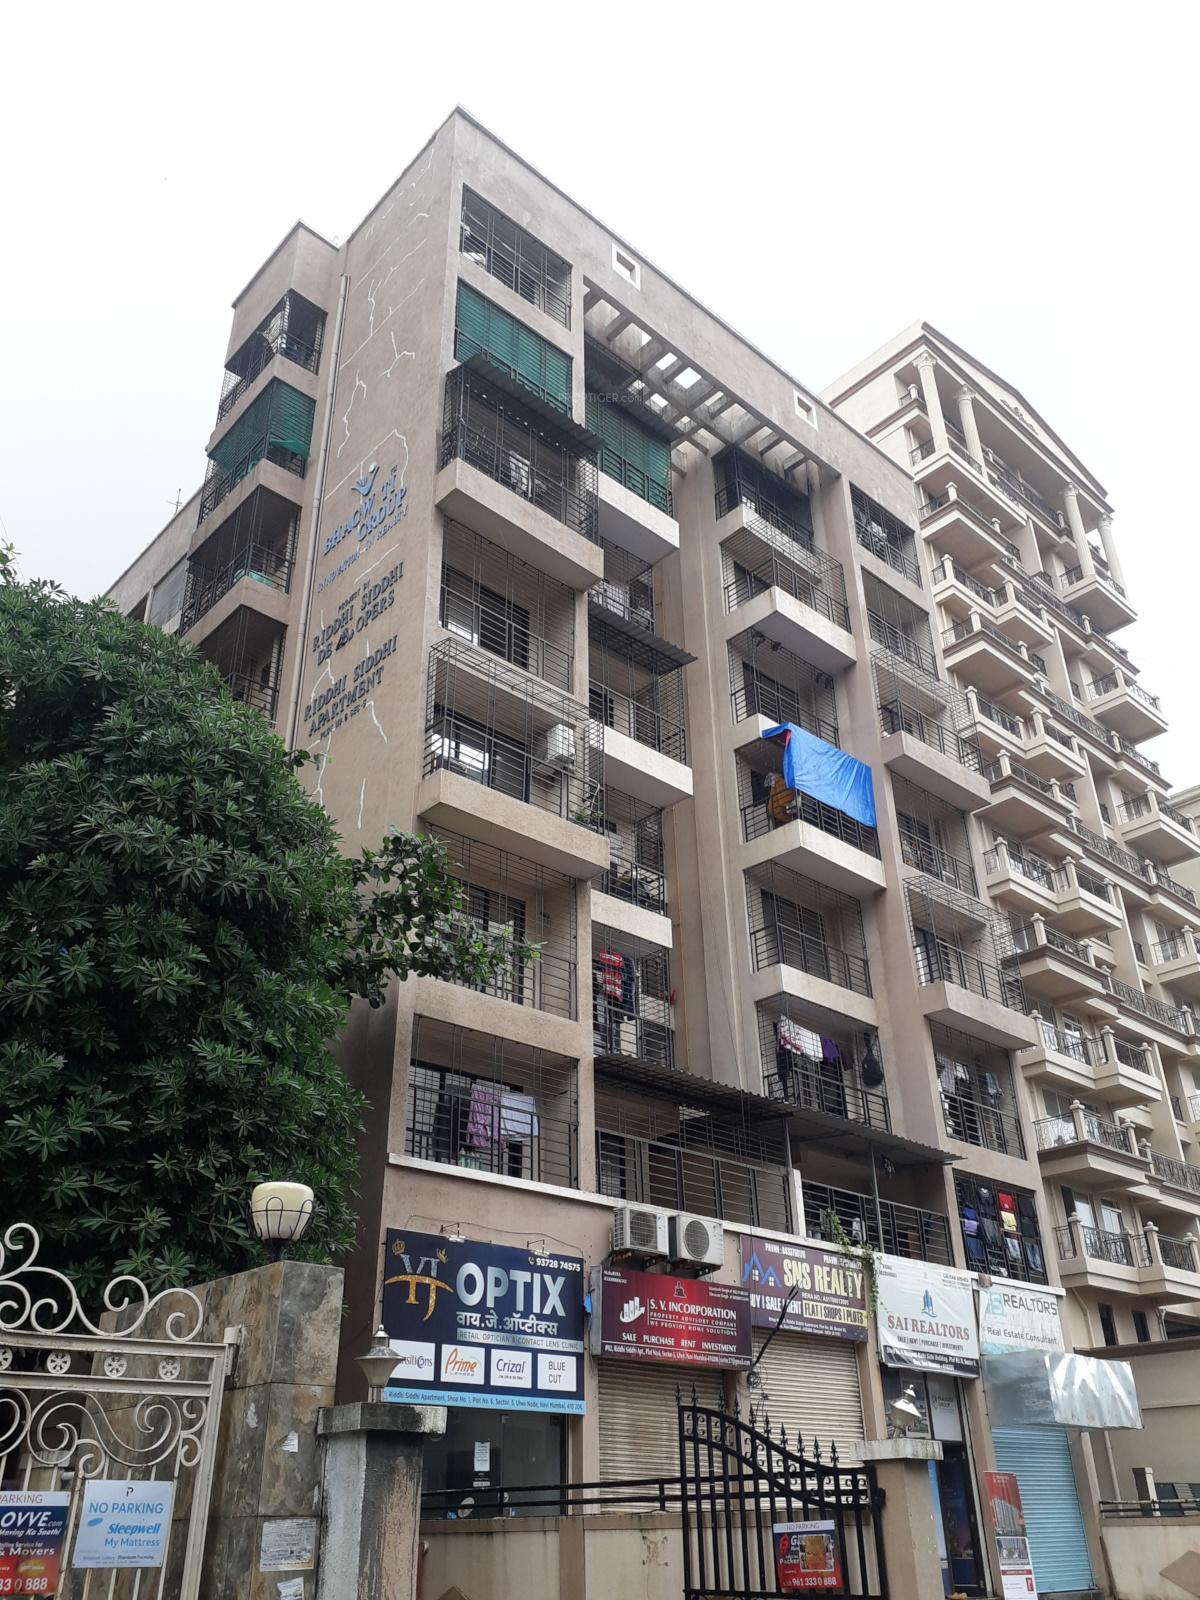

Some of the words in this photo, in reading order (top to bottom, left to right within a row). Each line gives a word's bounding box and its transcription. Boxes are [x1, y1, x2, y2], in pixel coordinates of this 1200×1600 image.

[313, 604, 354, 652] RIDDHI
[360, 561, 404, 611] SIDDHI
[304, 675, 347, 722] RIDDHI
[353, 634, 398, 683] SIDDHI
[308, 665, 385, 737] APARTMENT
[536, 1257, 558, 1268] 93728
[559, 1261, 581, 1272] 74575
[783, 1259, 812, 1290] SNS
[814, 1264, 863, 1299] REALTY
[456, 1262, 566, 1317] OPTIX
[650, 1299, 658, 1310] S.
[660, 1300, 667, 1311] V.
[669, 1301, 737, 1320] INCORPORATION
[750, 1294, 761, 1309] UY
[766, 1295, 782, 1311] SALE
[804, 1301, 820, 1318] FLAT
[824, 1304, 841, 1321] SHOPS
[847, 1307, 864, 1324] PLOTS
[1003, 1293, 1057, 1316] REALTORS
[650, 1312, 679, 1320] PROPERTY
[681, 1315, 709, 1324] ADVISORY
[711, 1319, 737, 1328] COMPANY
[887, 1314, 909, 1331] SAI
[911, 1318, 970, 1341] REALTORS
[660, 1322, 686, 1331] PROVIDE
[688, 1325, 704, 1334] HOME
[706, 1327, 737, 1337] SOLUTIONS
[987, 1326, 1002, 1336] Real
[1003, 1329, 1024, 1340] Estate
[1025, 1332, 1057, 1345] Consultant
[459, 1331, 480, 1340] RETAIL
[482, 1333, 512, 1344] OPTICIAN
[518, 1337, 544, 1347] CONTACT
[545, 1339, 561, 1348] LENS
[561, 1340, 580, 1350] CLINIC
[622, 1332, 637, 1342] SALE
[643, 1334, 675, 1346] PURCHASE
[681, 1339, 696, 1349] RENT
[701, 1341, 737, 1353] INVESTMENT
[897, 1335, 906, 1344] SALE
[921, 1339, 939, 1348] PURCHASE
[445, 1348, 478, 1374] Prime
[496, 1358, 526, 1374] Crizal
[548, 1361, 566, 1372] BLUE
[548, 1374, 562, 1384] CUT
[0, 1494, 43, 1504] ARKING
[89, 1503, 108, 1514] NO
[112, 1503, 164, 1514] PARKING
[107, 1523, 161, 1535] Sleepwell
[795, 1522, 820, 1530] PARKING
[105, 1538, 119, 1548] My
[120, 1537, 160, 1547] Mattress
[9, 1547, 55, 1556] Movers
[25, 1577, 48, 1591] 888
[792, 1578, 804, 1587] 961
[804, 1577, 817, 1586] 333
[823, 1576, 837, 1586] 888
